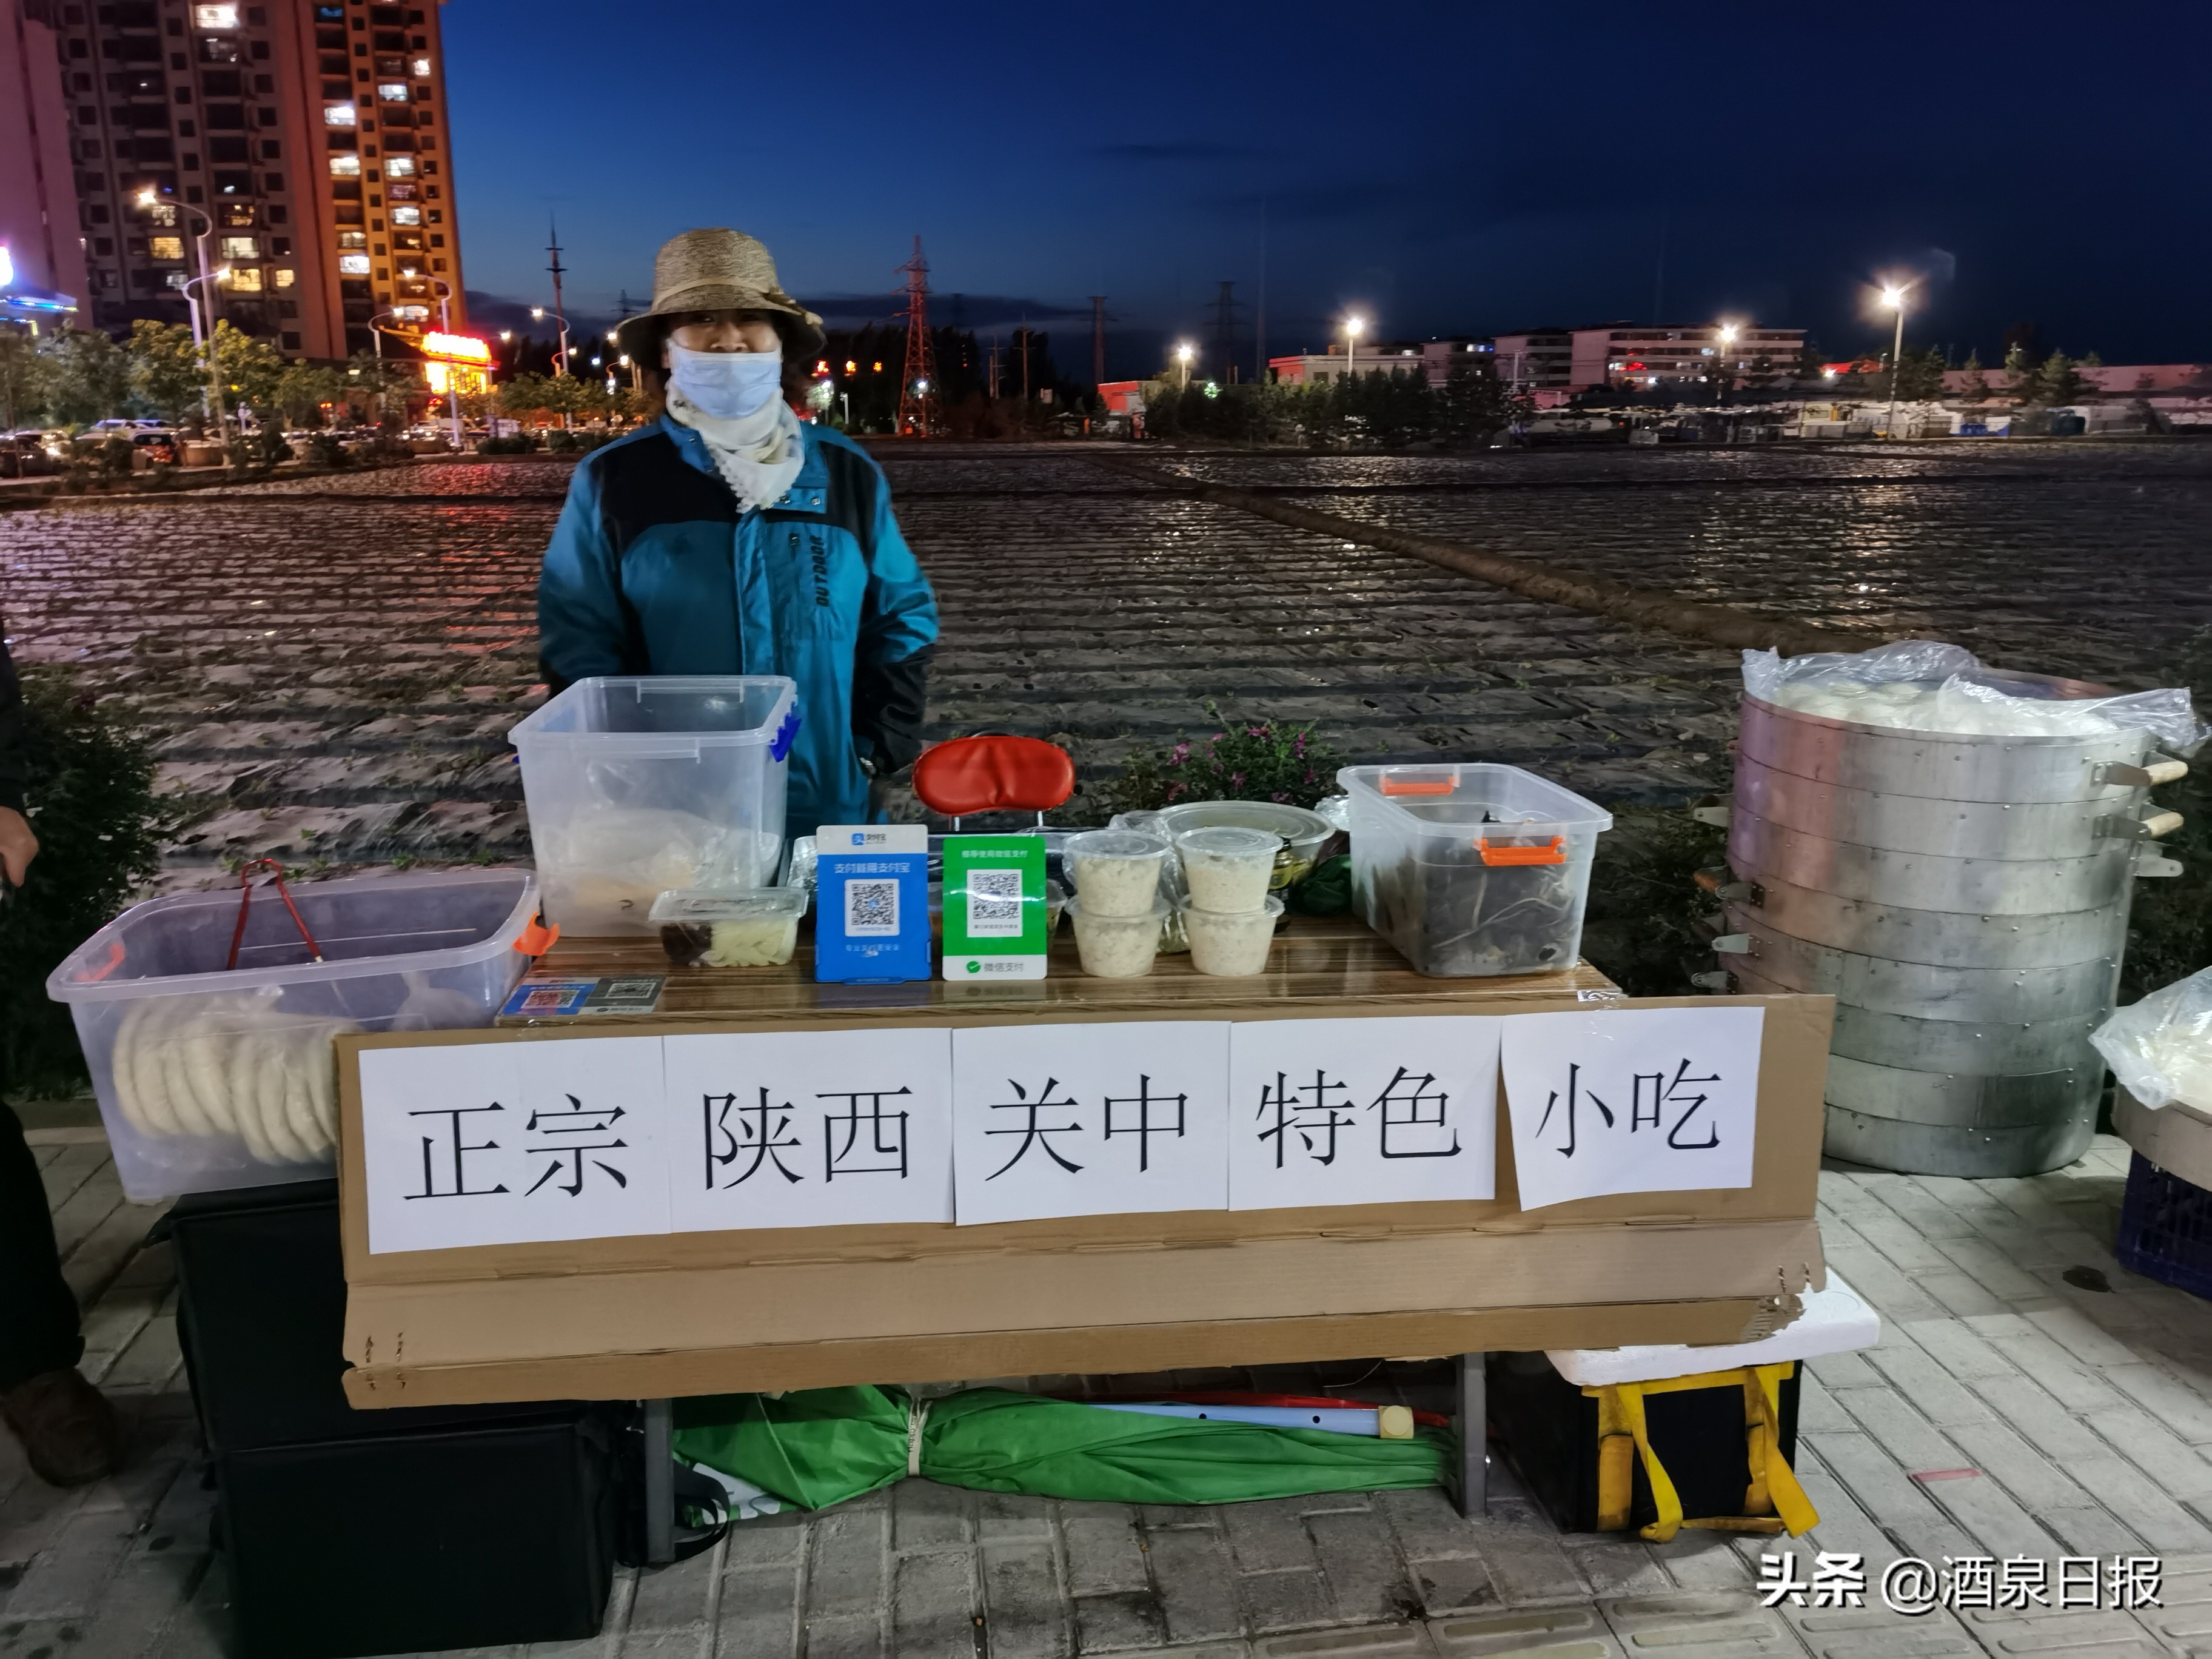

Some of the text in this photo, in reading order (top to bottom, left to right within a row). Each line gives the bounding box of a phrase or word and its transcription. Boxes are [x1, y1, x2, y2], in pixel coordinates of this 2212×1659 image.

[809, 535, 830, 606] OUTDOOR
[984, 962, 1024, 972] 微信支付
[403, 1057, 1722, 1201] 正宗 陕西 关中 特色 小吃
